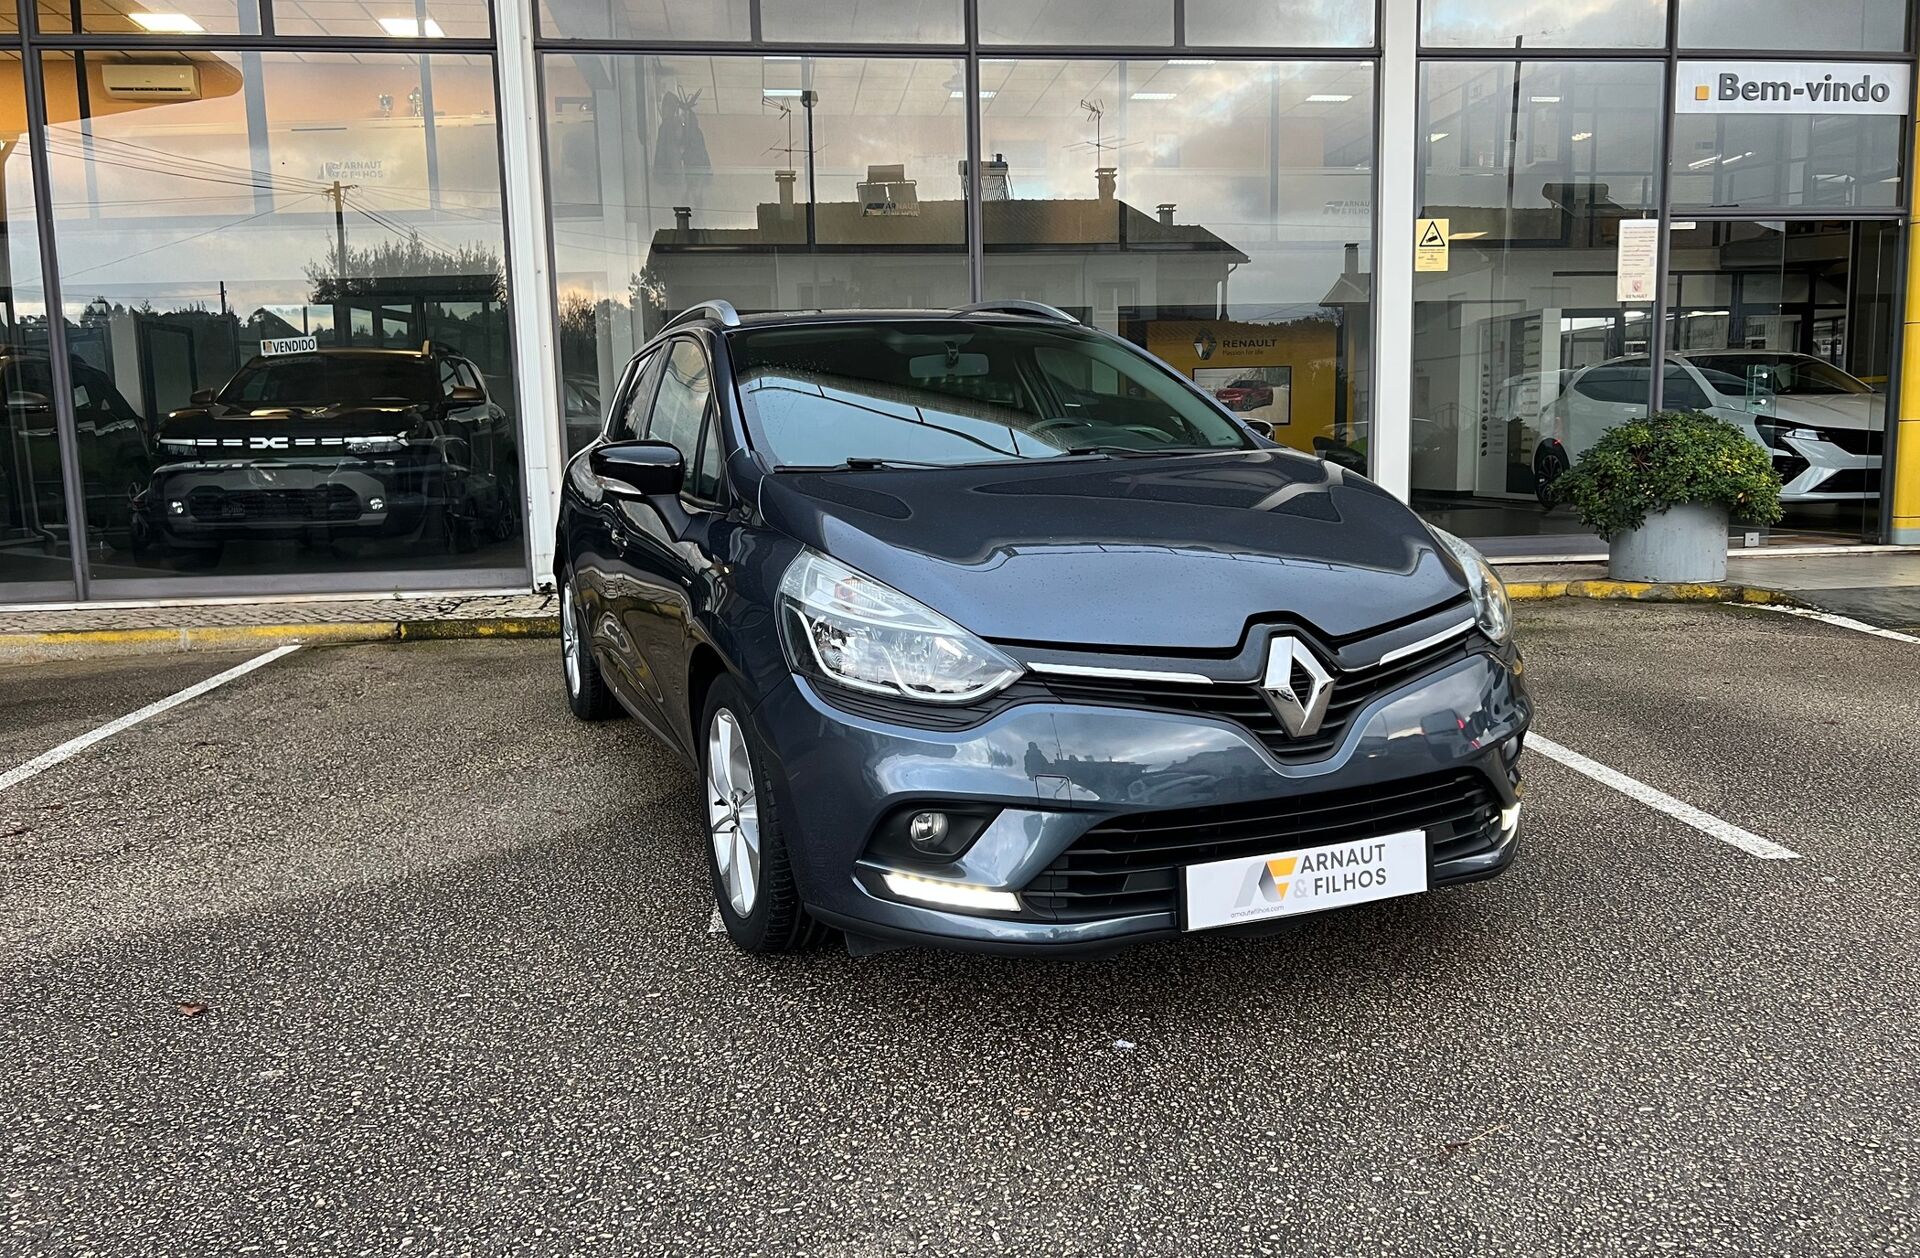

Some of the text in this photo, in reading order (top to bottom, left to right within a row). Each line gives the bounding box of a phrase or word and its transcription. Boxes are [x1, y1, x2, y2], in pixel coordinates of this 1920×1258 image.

[1718, 73, 1890, 102] Bem-vindo
[344, 161, 382, 169] ARNAUT
[273, 339, 315, 352] VENDIDO
[1223, 339, 1277, 348] RENAULT
[1300, 843, 1385, 874] ARNAUT
[1293, 867, 1387, 899] & FILHOS
